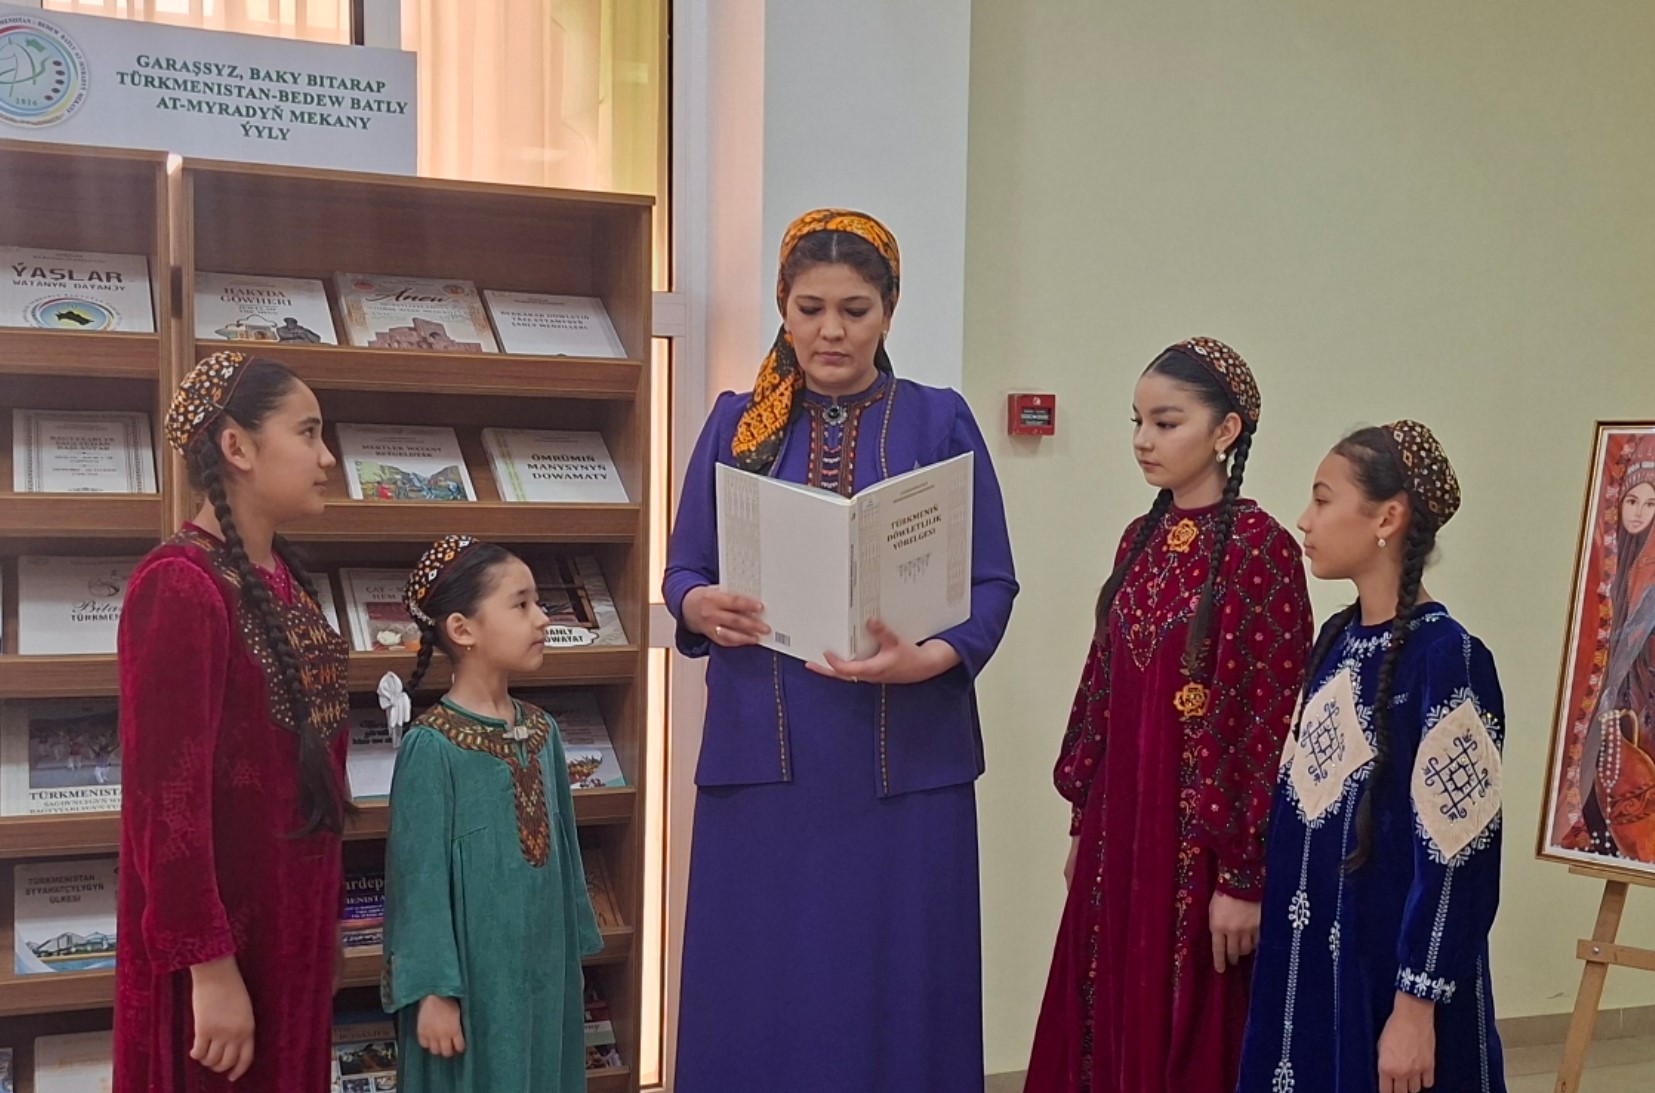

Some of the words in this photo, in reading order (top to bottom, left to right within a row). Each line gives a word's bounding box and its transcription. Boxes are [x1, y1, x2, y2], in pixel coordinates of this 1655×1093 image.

[136, 54, 243, 81] GARAŞSYZ,
[249, 67, 302, 85] BAKY
[306, 73, 386, 93] BITARAP
[116, 70, 345, 108] TÜRKMENISTAN-BEDEW
[349, 97, 408, 115] BATLY
[156, 96, 284, 121] AT-MYRADYŇ
[289, 109, 371, 130] MEKANY
[240, 121, 291, 141] ÝYLY
[532, 472, 607, 480] DOWAMATY
[29, 788, 121, 801] TÜRKMENIST
